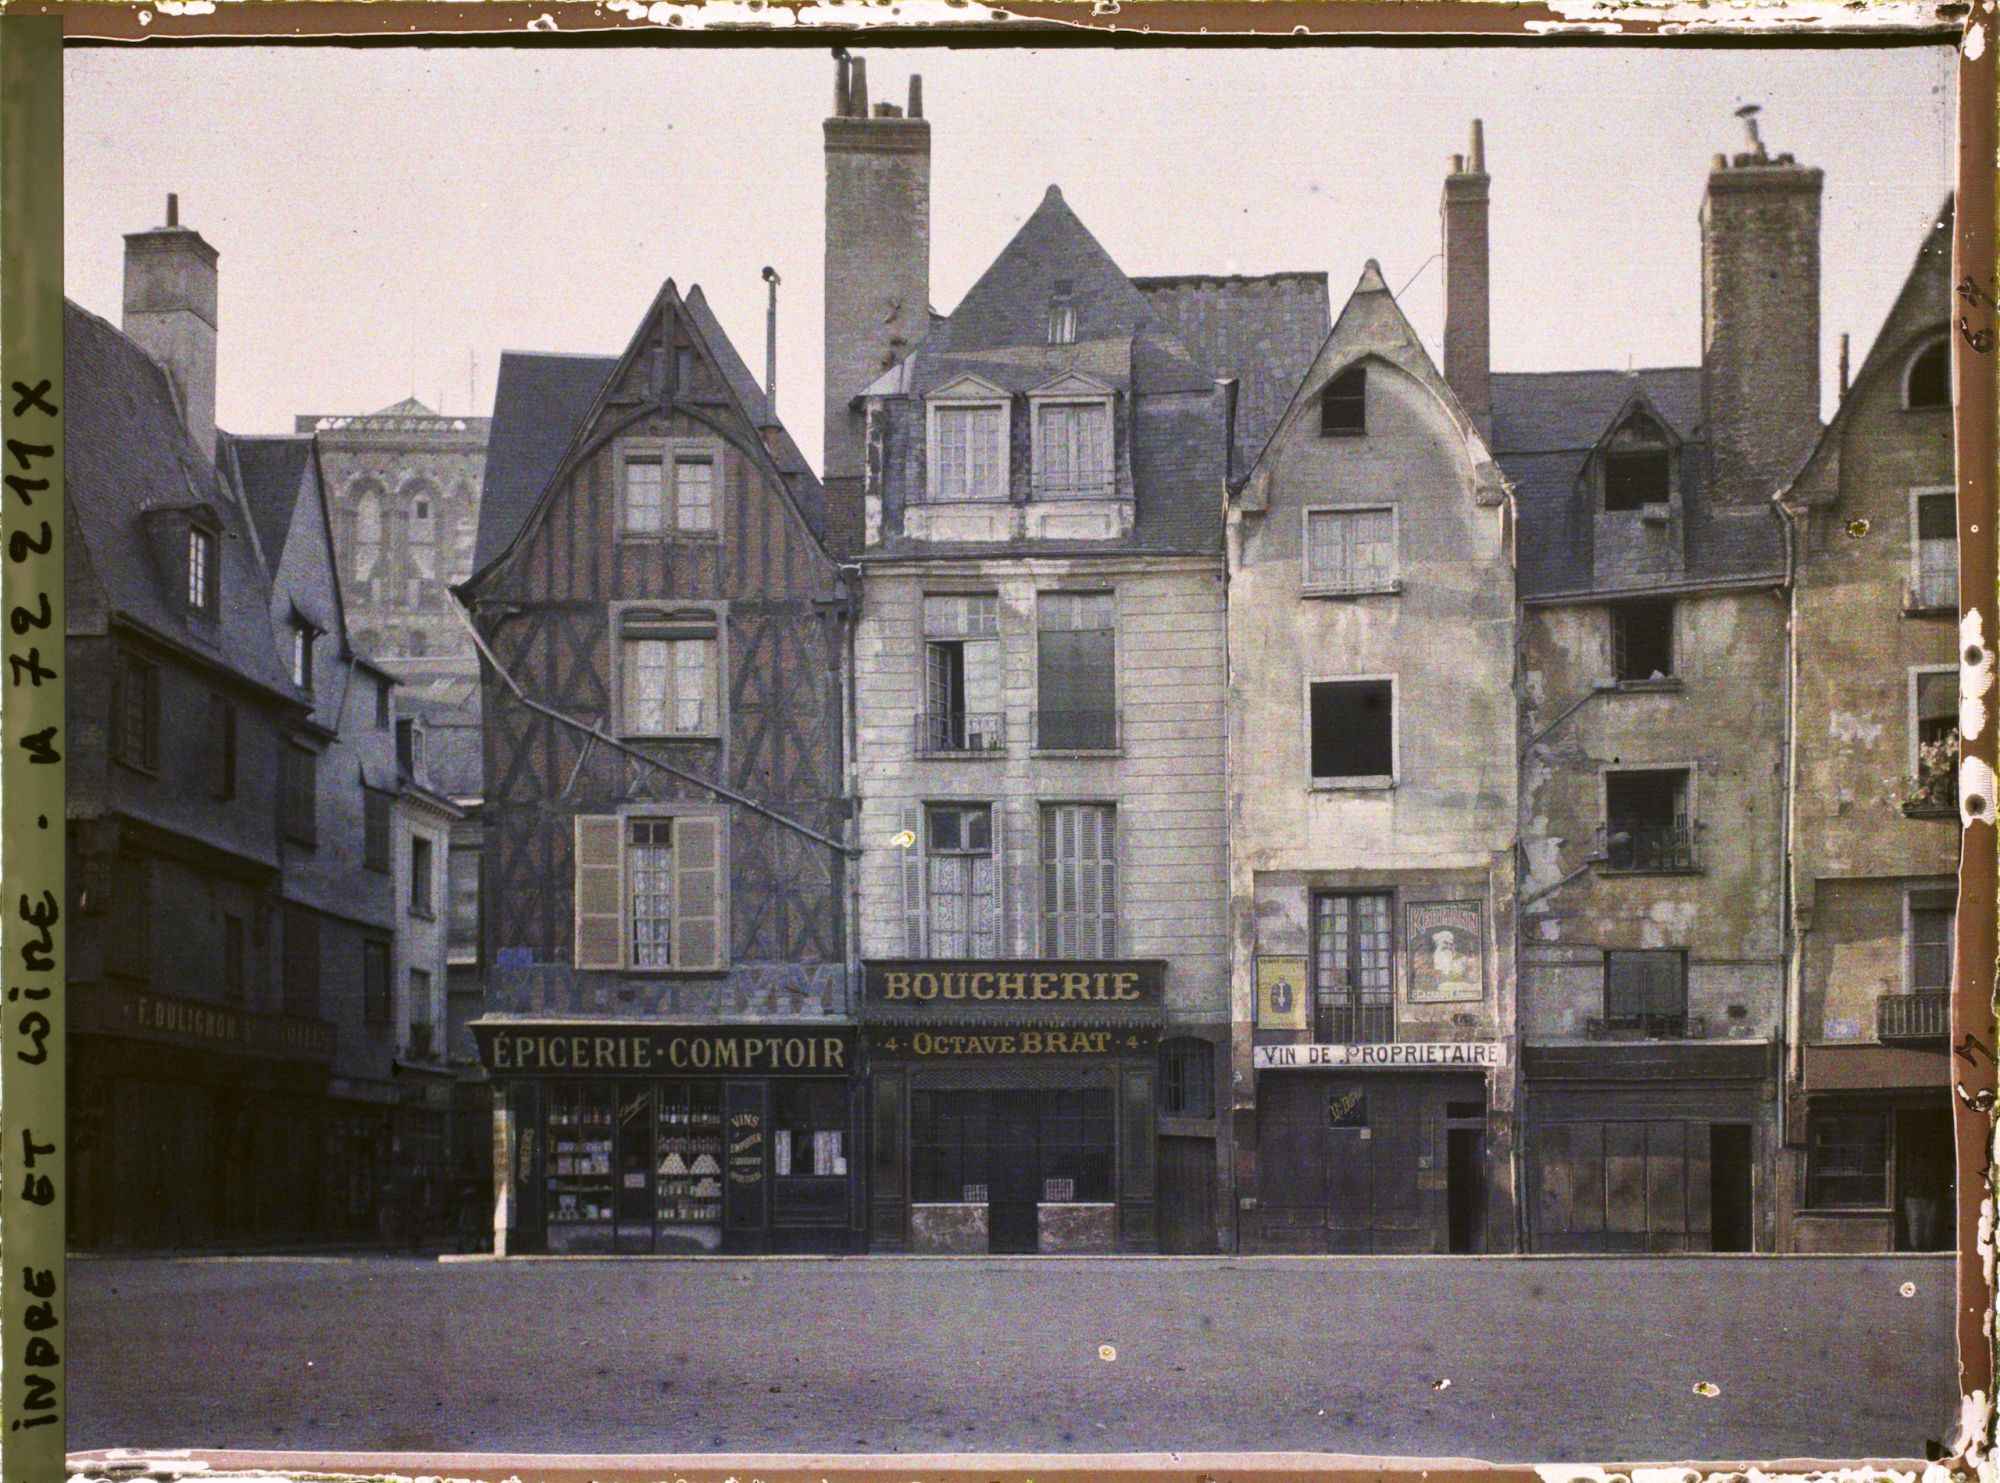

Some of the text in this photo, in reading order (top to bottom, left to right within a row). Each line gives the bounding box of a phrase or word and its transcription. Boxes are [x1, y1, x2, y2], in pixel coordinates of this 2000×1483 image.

[20, 727, 61, 764] A
[884, 972, 1140, 1000] BOUCHERIE
[493, 1031, 845, 1068] ÉPICERIE COMPTOIR
[885, 1031, 1138, 1054] 4 OCTAVE BRAT 4
[1263, 1044, 1497, 1065] VIN DE PROPRIETAIRE
[731, 1113, 760, 1128] VINS
[22, 1128, 56, 1205] ET
